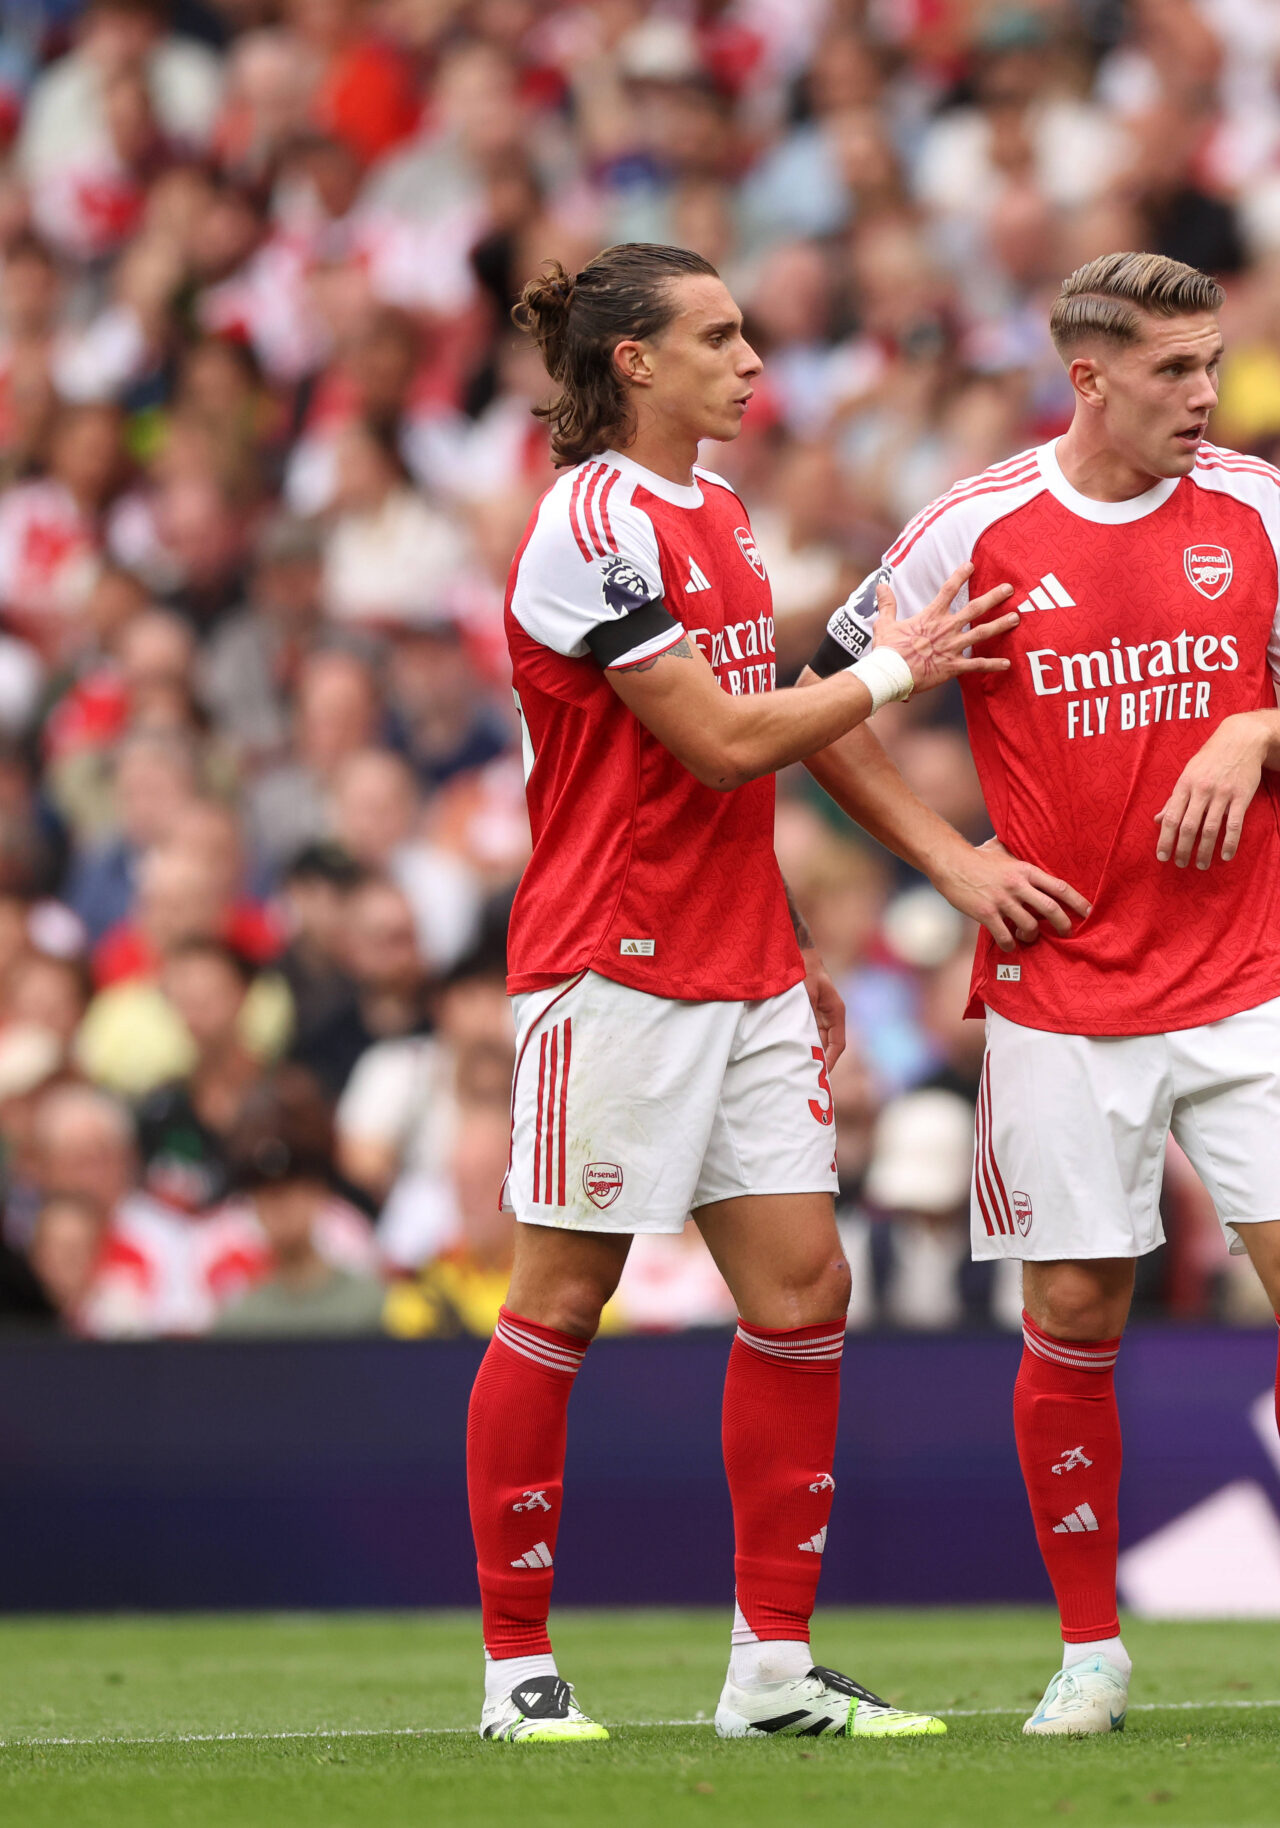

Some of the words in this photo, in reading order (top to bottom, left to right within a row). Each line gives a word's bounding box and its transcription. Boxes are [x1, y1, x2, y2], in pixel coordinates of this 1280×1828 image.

[1025, 628, 1239, 696] Emirates
[1067, 696, 1109, 740] FLY
[1120, 681, 1211, 731] BETTER
[588, 1170, 617, 1178] Arsenal
